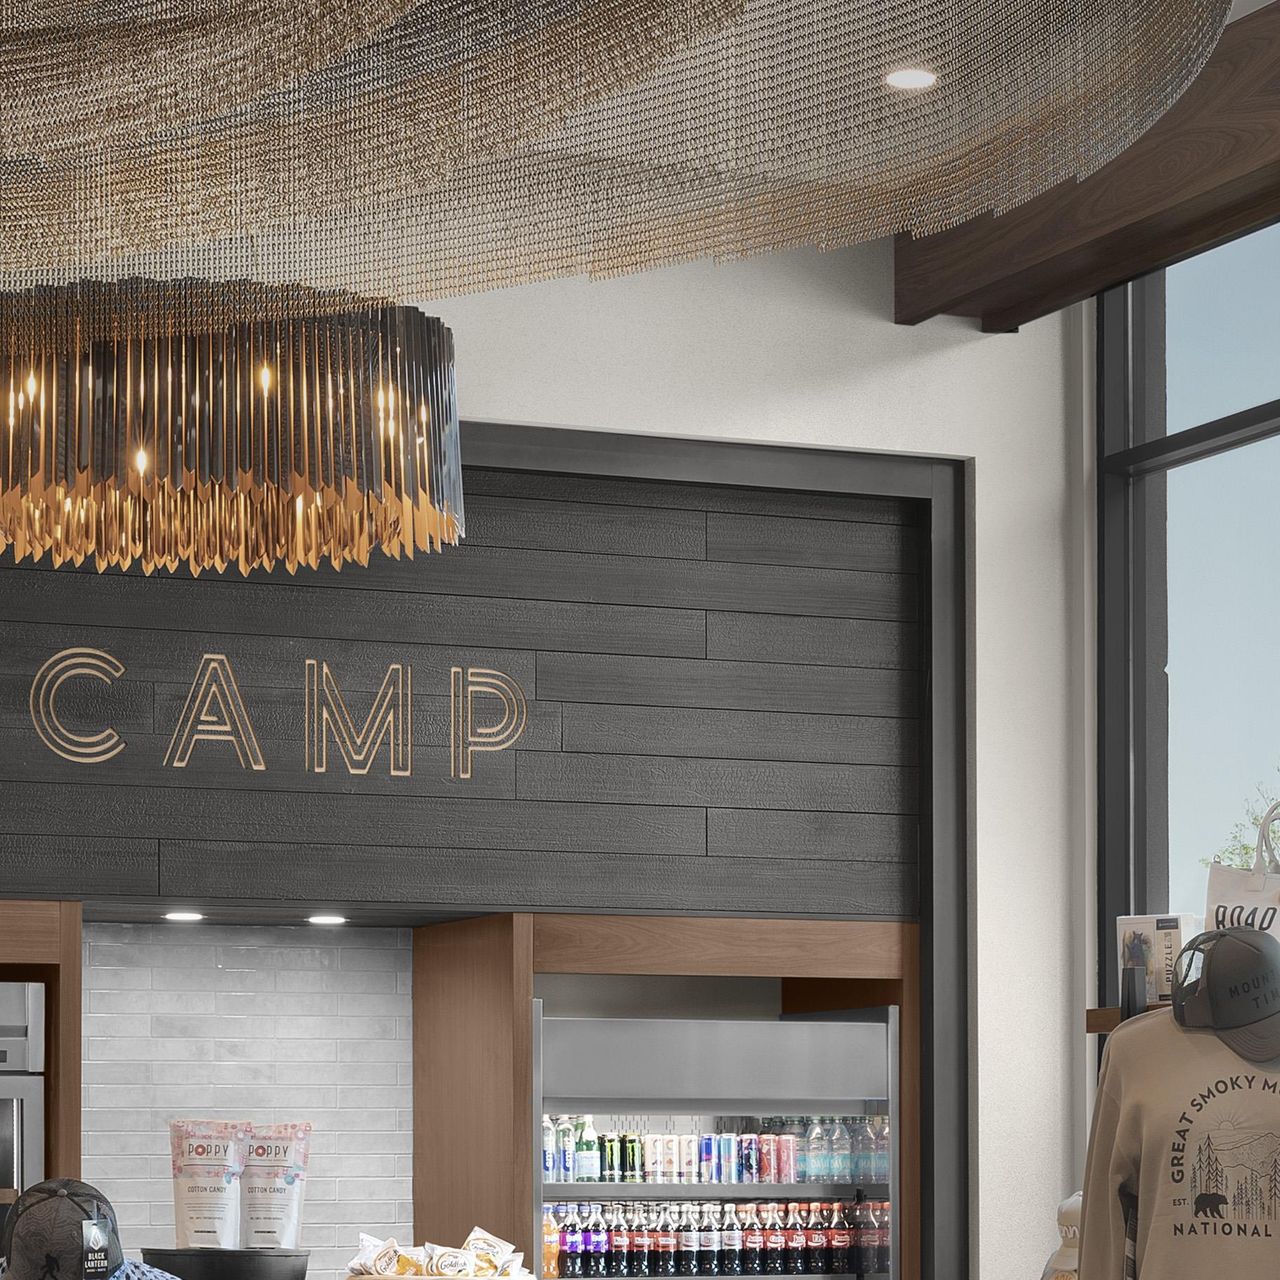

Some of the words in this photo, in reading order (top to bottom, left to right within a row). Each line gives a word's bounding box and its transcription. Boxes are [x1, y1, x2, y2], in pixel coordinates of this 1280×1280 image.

[1215, 904, 1277, 932] ROAD
[1165, 943, 1173, 984] PUZZLE
[1171, 1111, 1194, 1184] GREAT
[1190, 1075, 1257, 1113] SMOKY
[268, 1186, 287, 1194] CANDY
[1173, 1222, 1272, 1237] NATIONAL
